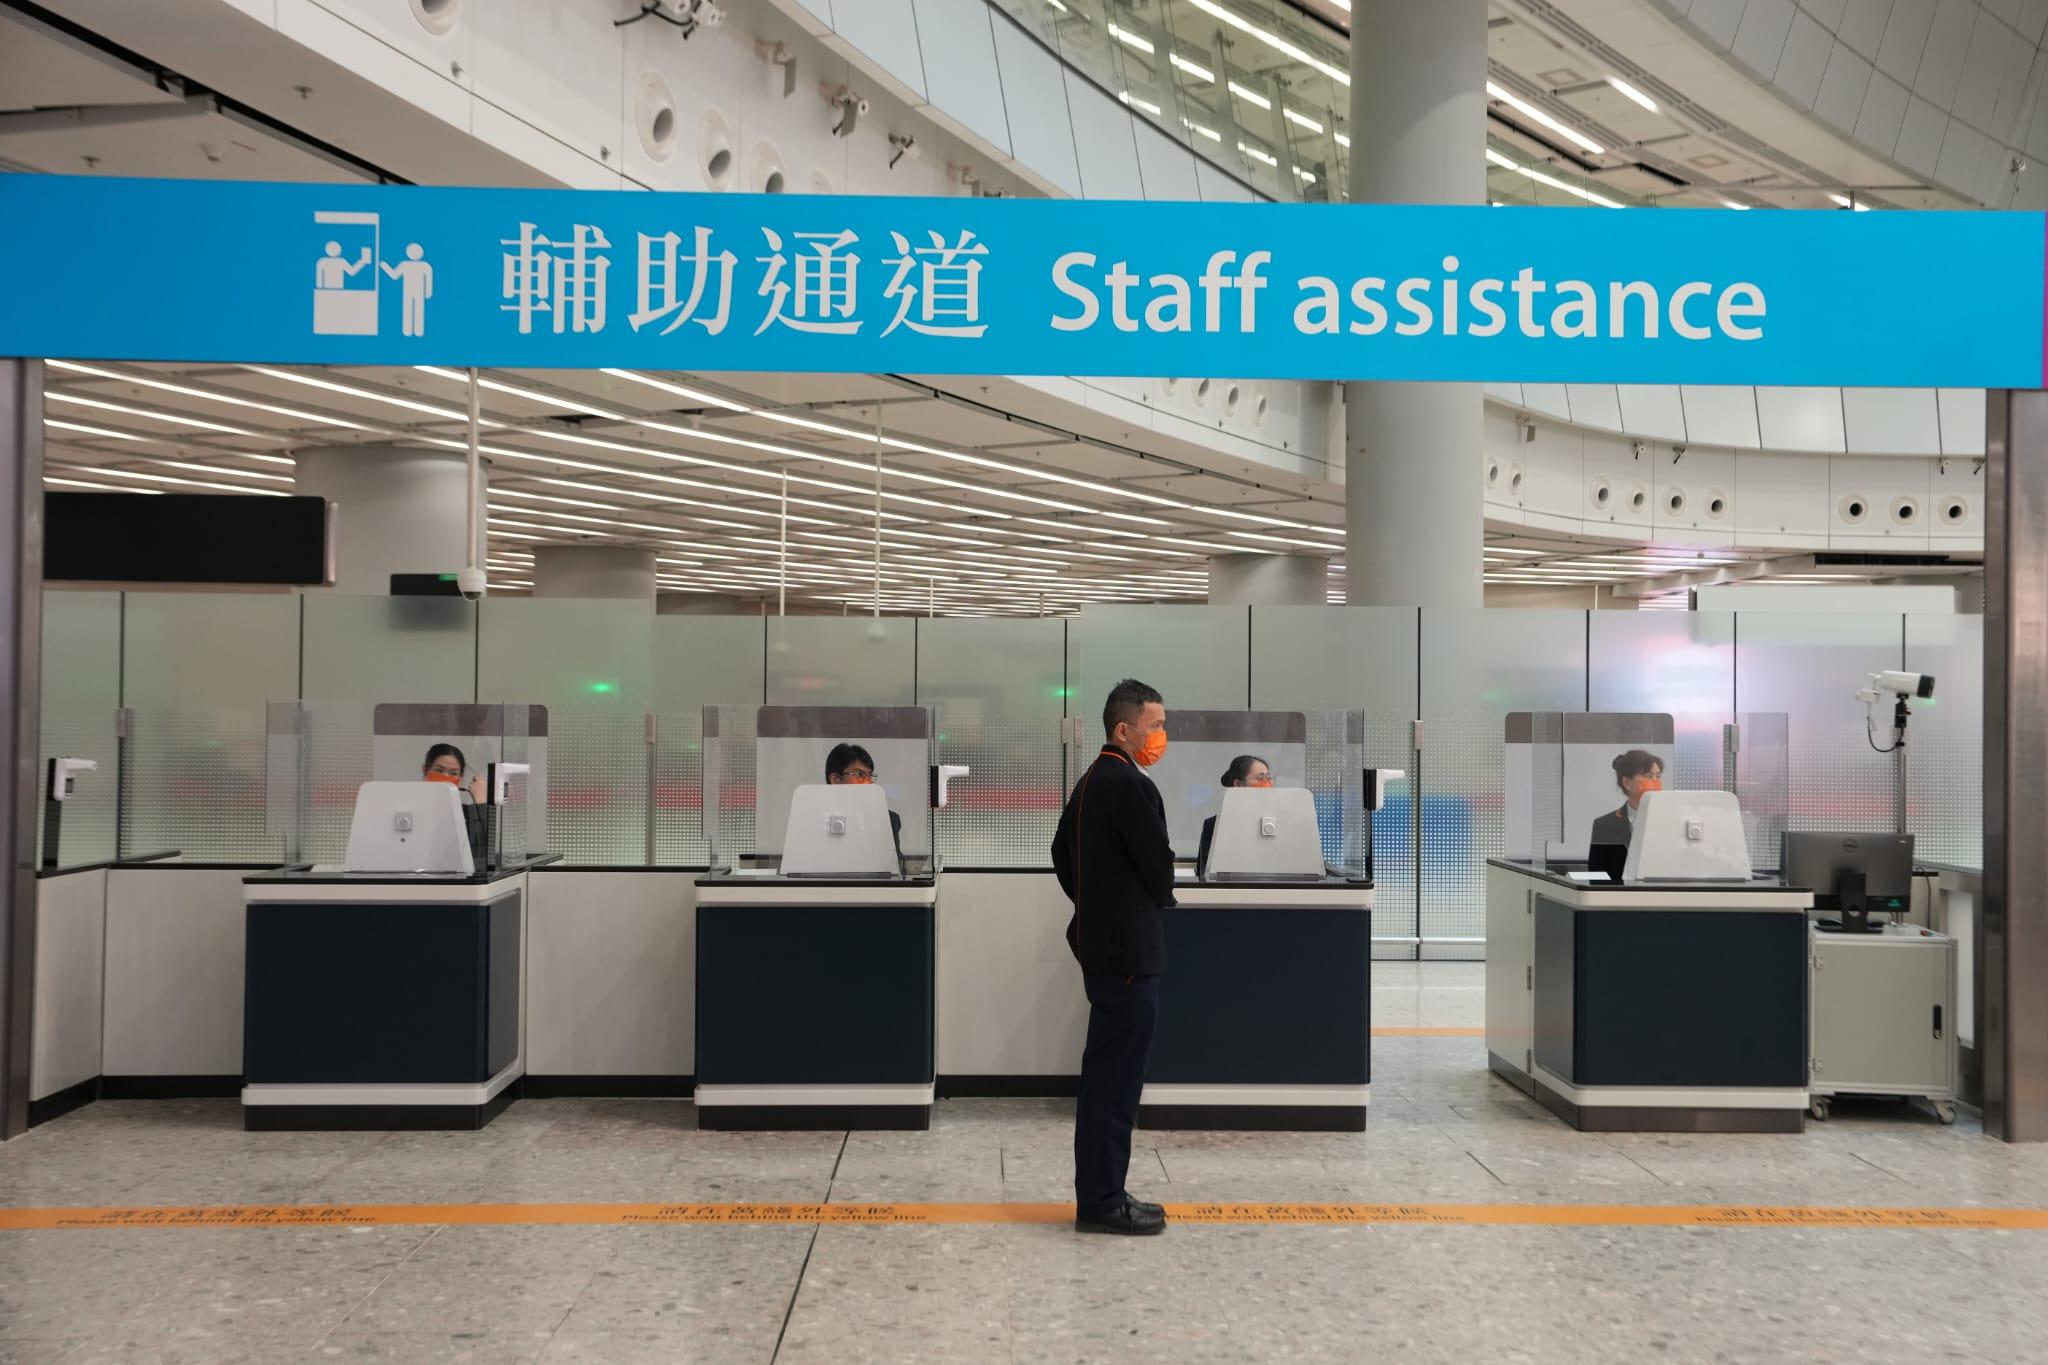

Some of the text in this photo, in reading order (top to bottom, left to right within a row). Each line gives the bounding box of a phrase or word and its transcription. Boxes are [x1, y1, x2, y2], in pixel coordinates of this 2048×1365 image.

[500, 222, 989, 338] 輔助通道
[1050, 249, 1768, 342] Staff assistance
